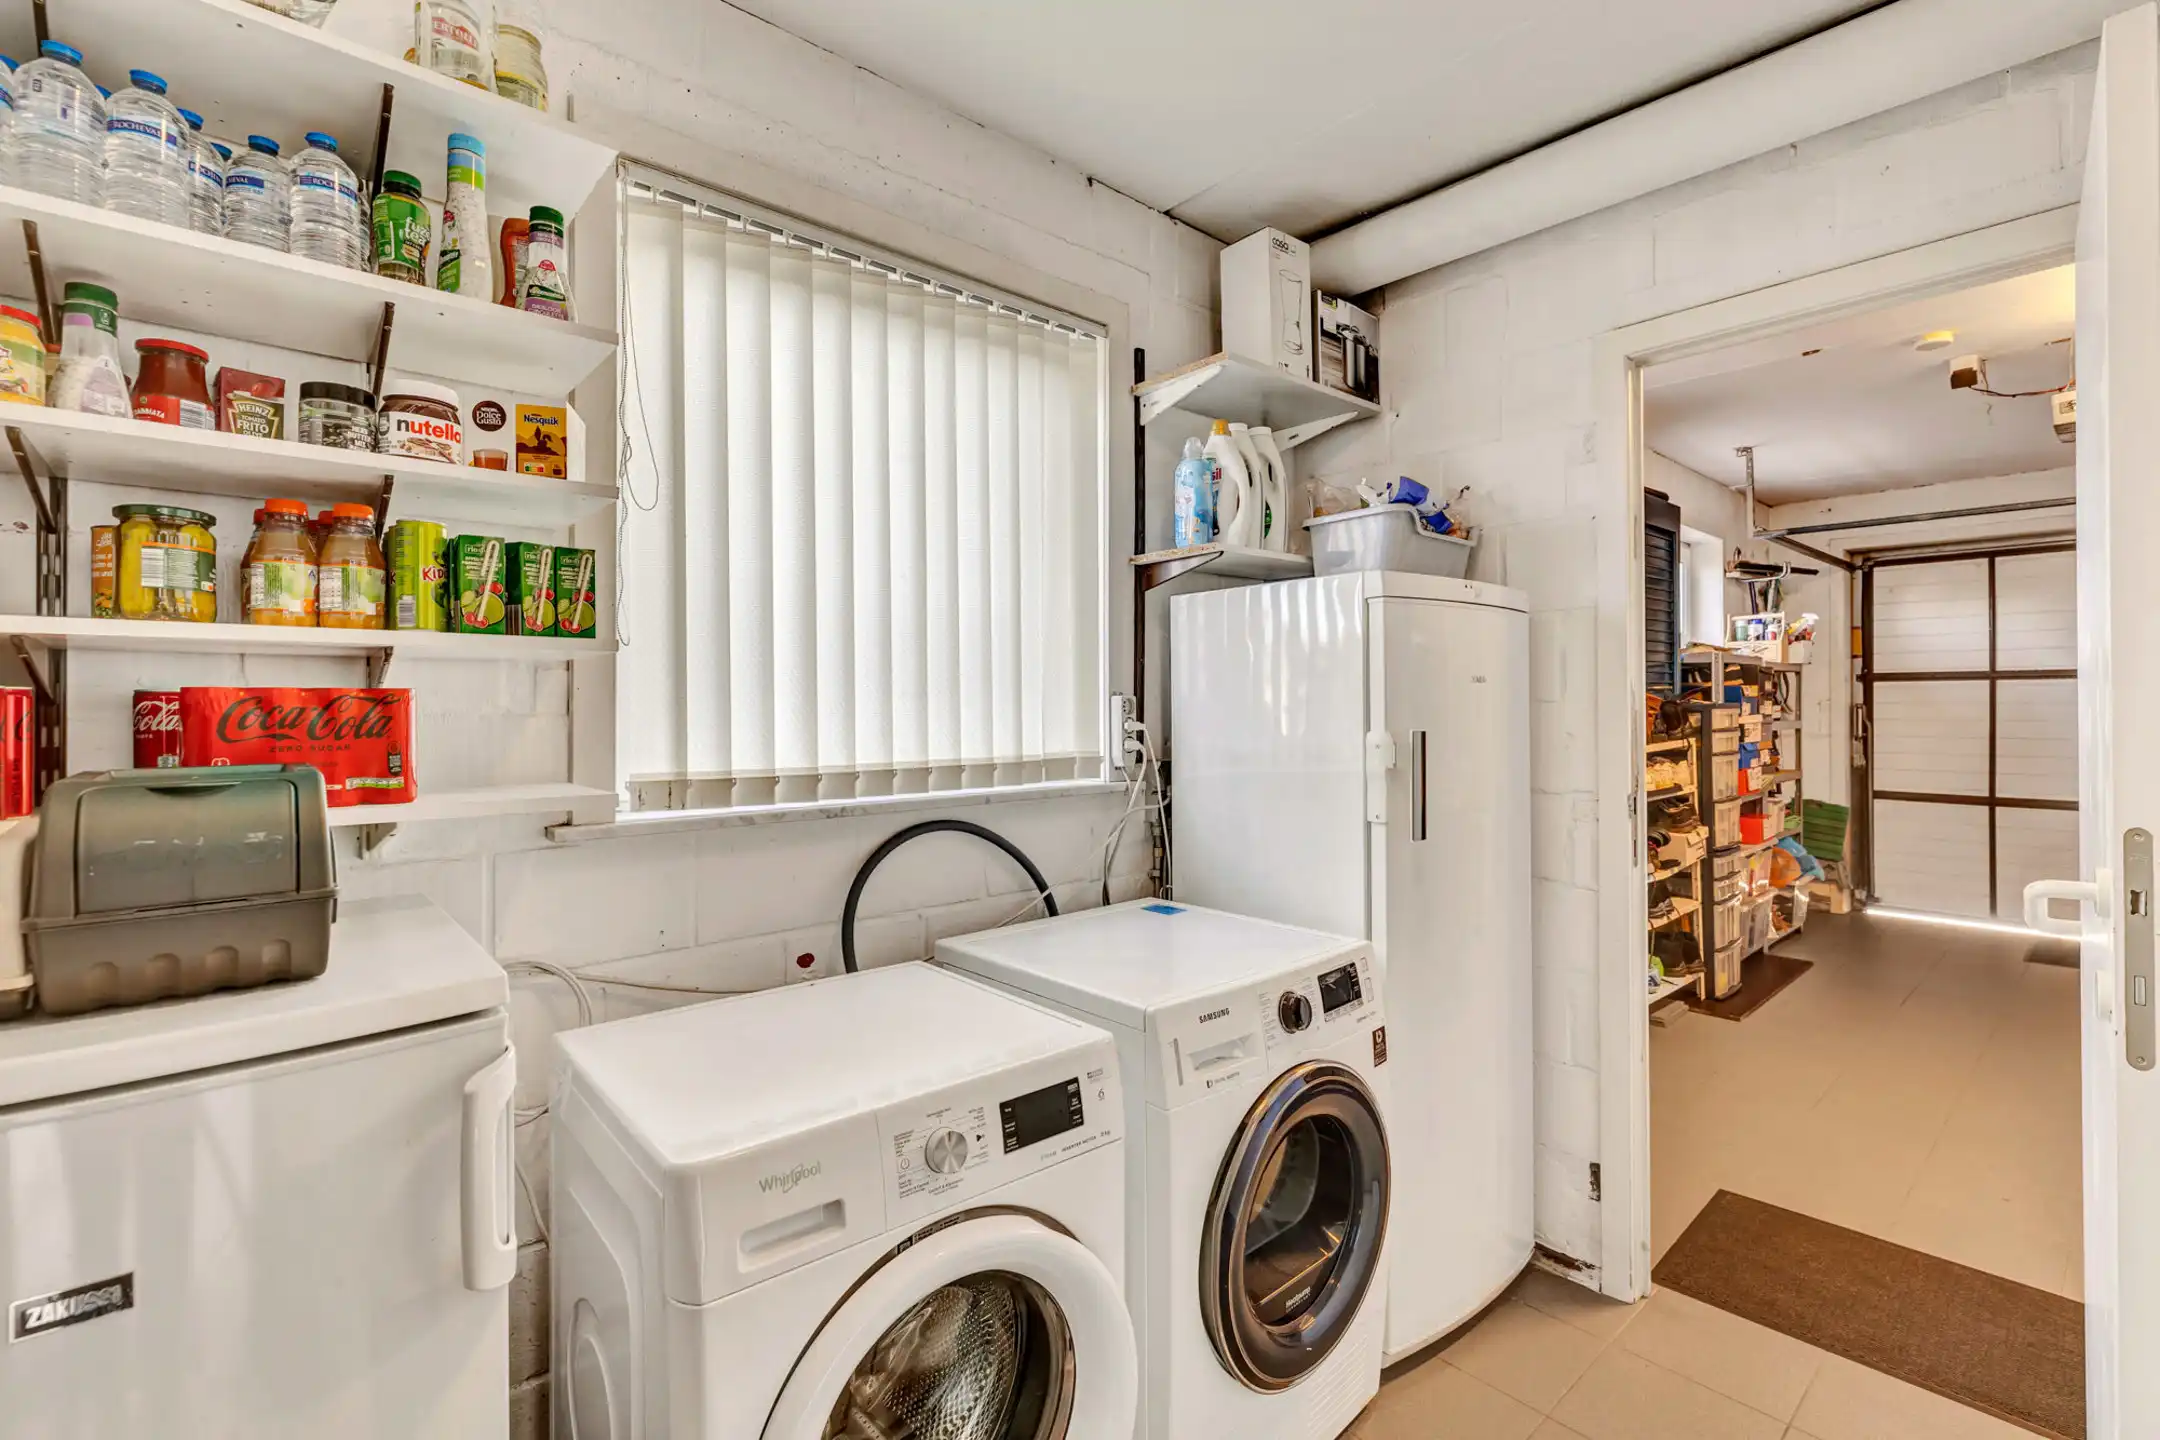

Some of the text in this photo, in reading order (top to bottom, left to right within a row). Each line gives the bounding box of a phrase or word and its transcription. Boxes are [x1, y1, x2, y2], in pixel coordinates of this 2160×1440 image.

[404, 216, 431, 241] fuze
[404, 227, 426, 247] tea
[1271, 237, 1289, 250] casa
[238, 403, 270, 417] HEINZ
[241, 415, 266, 424] TOMATO
[524, 414, 560, 427] Nesquik
[236, 420, 269, 434] FRITO
[397, 419, 462, 445] nutella
[1211, 468, 1222, 481] sil
[1199, 1007, 1230, 1024] SAMSUNG
[758, 1159, 822, 1194] Whirlpool
